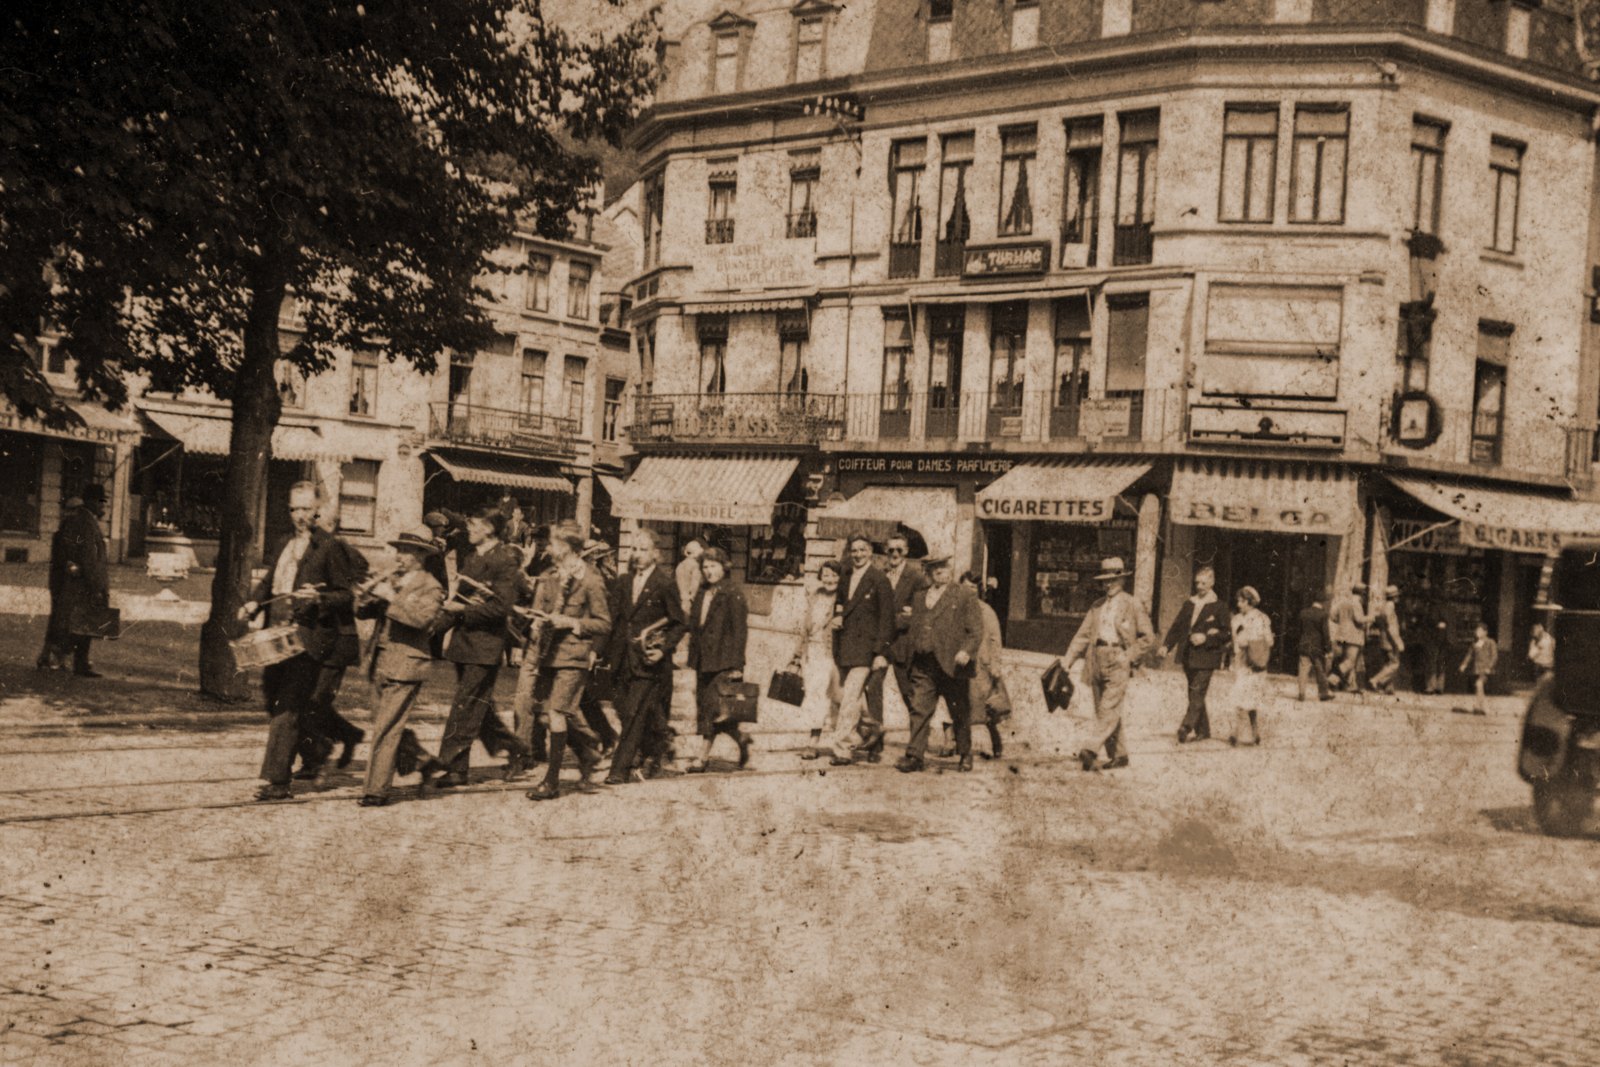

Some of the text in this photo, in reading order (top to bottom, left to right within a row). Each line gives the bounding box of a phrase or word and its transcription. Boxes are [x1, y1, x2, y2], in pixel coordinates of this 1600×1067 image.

[838, 458, 1014, 472] COIFFEUR POUR DAMES PARFUMERIE
[673, 504, 735, 519] RASUREL
[981, 499, 1104, 516] CIGARETTES
